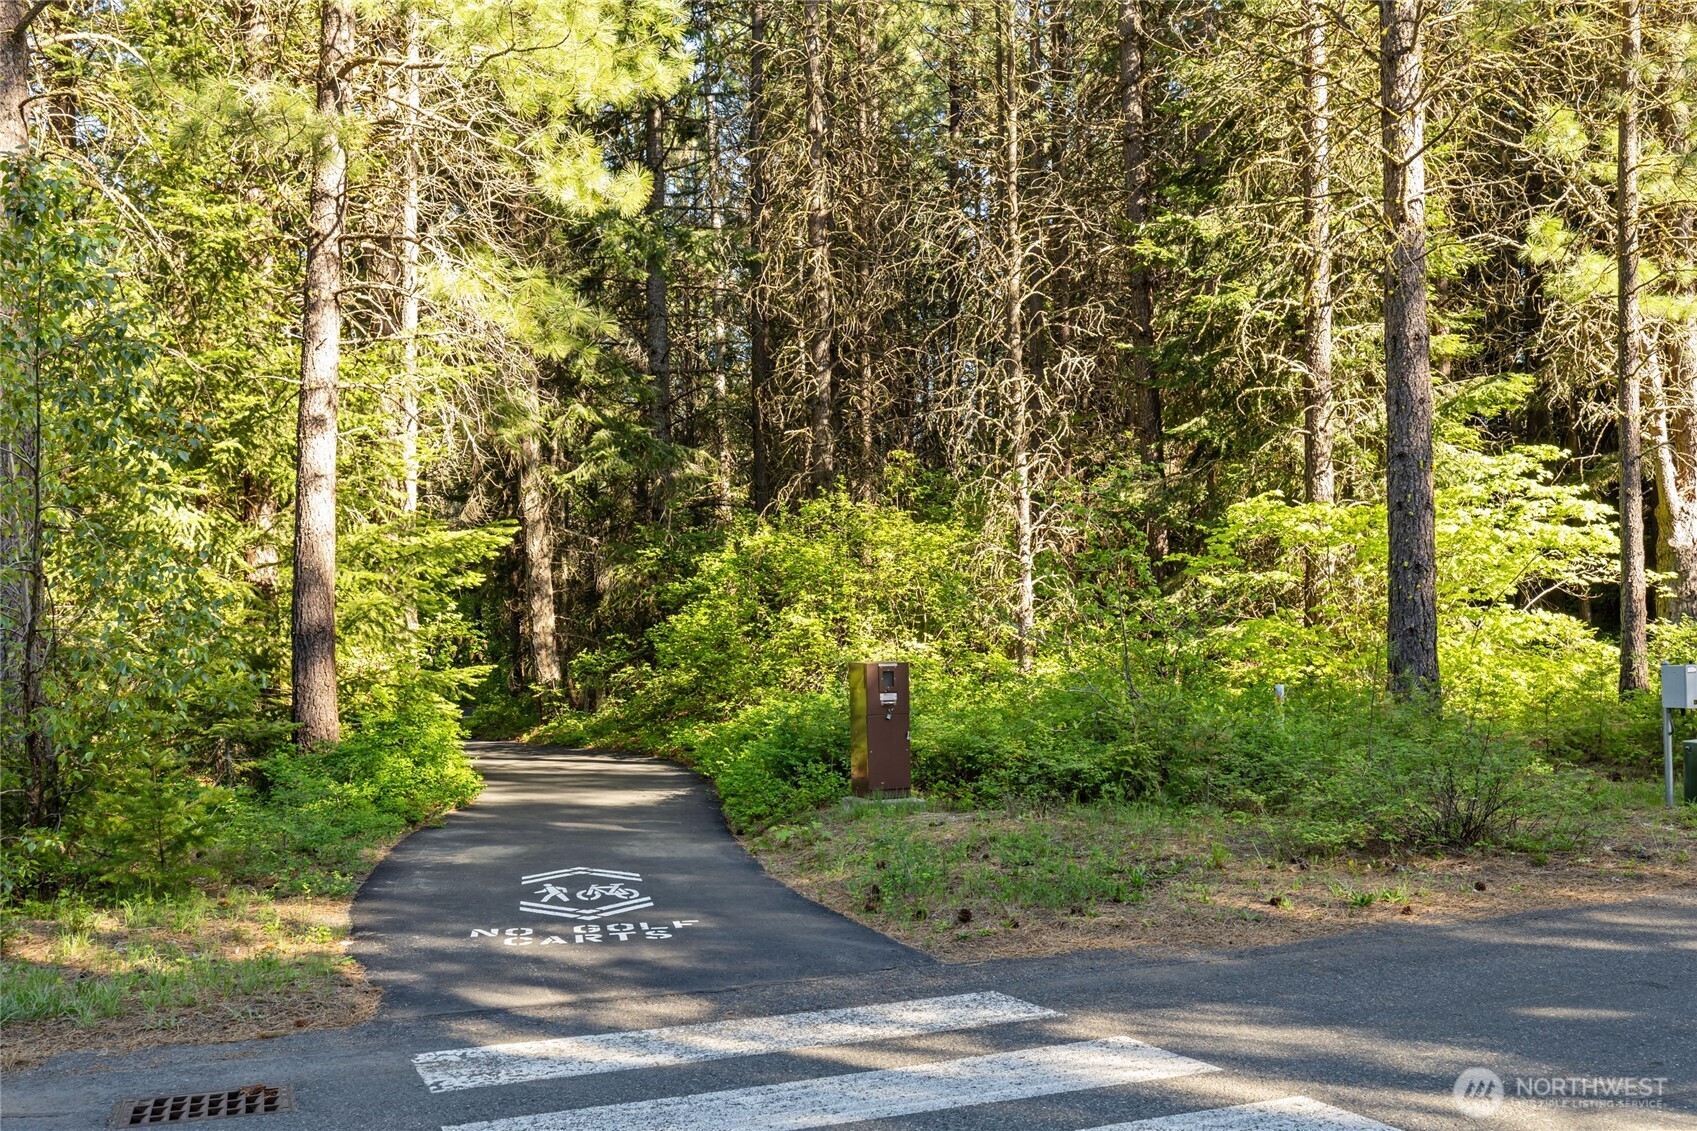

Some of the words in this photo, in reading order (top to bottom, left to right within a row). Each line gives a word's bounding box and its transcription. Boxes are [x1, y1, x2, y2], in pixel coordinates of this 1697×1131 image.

[470, 927, 534, 938] NO
[573, 919, 699, 934] GOLF
[503, 930, 673, 946] CARTS
